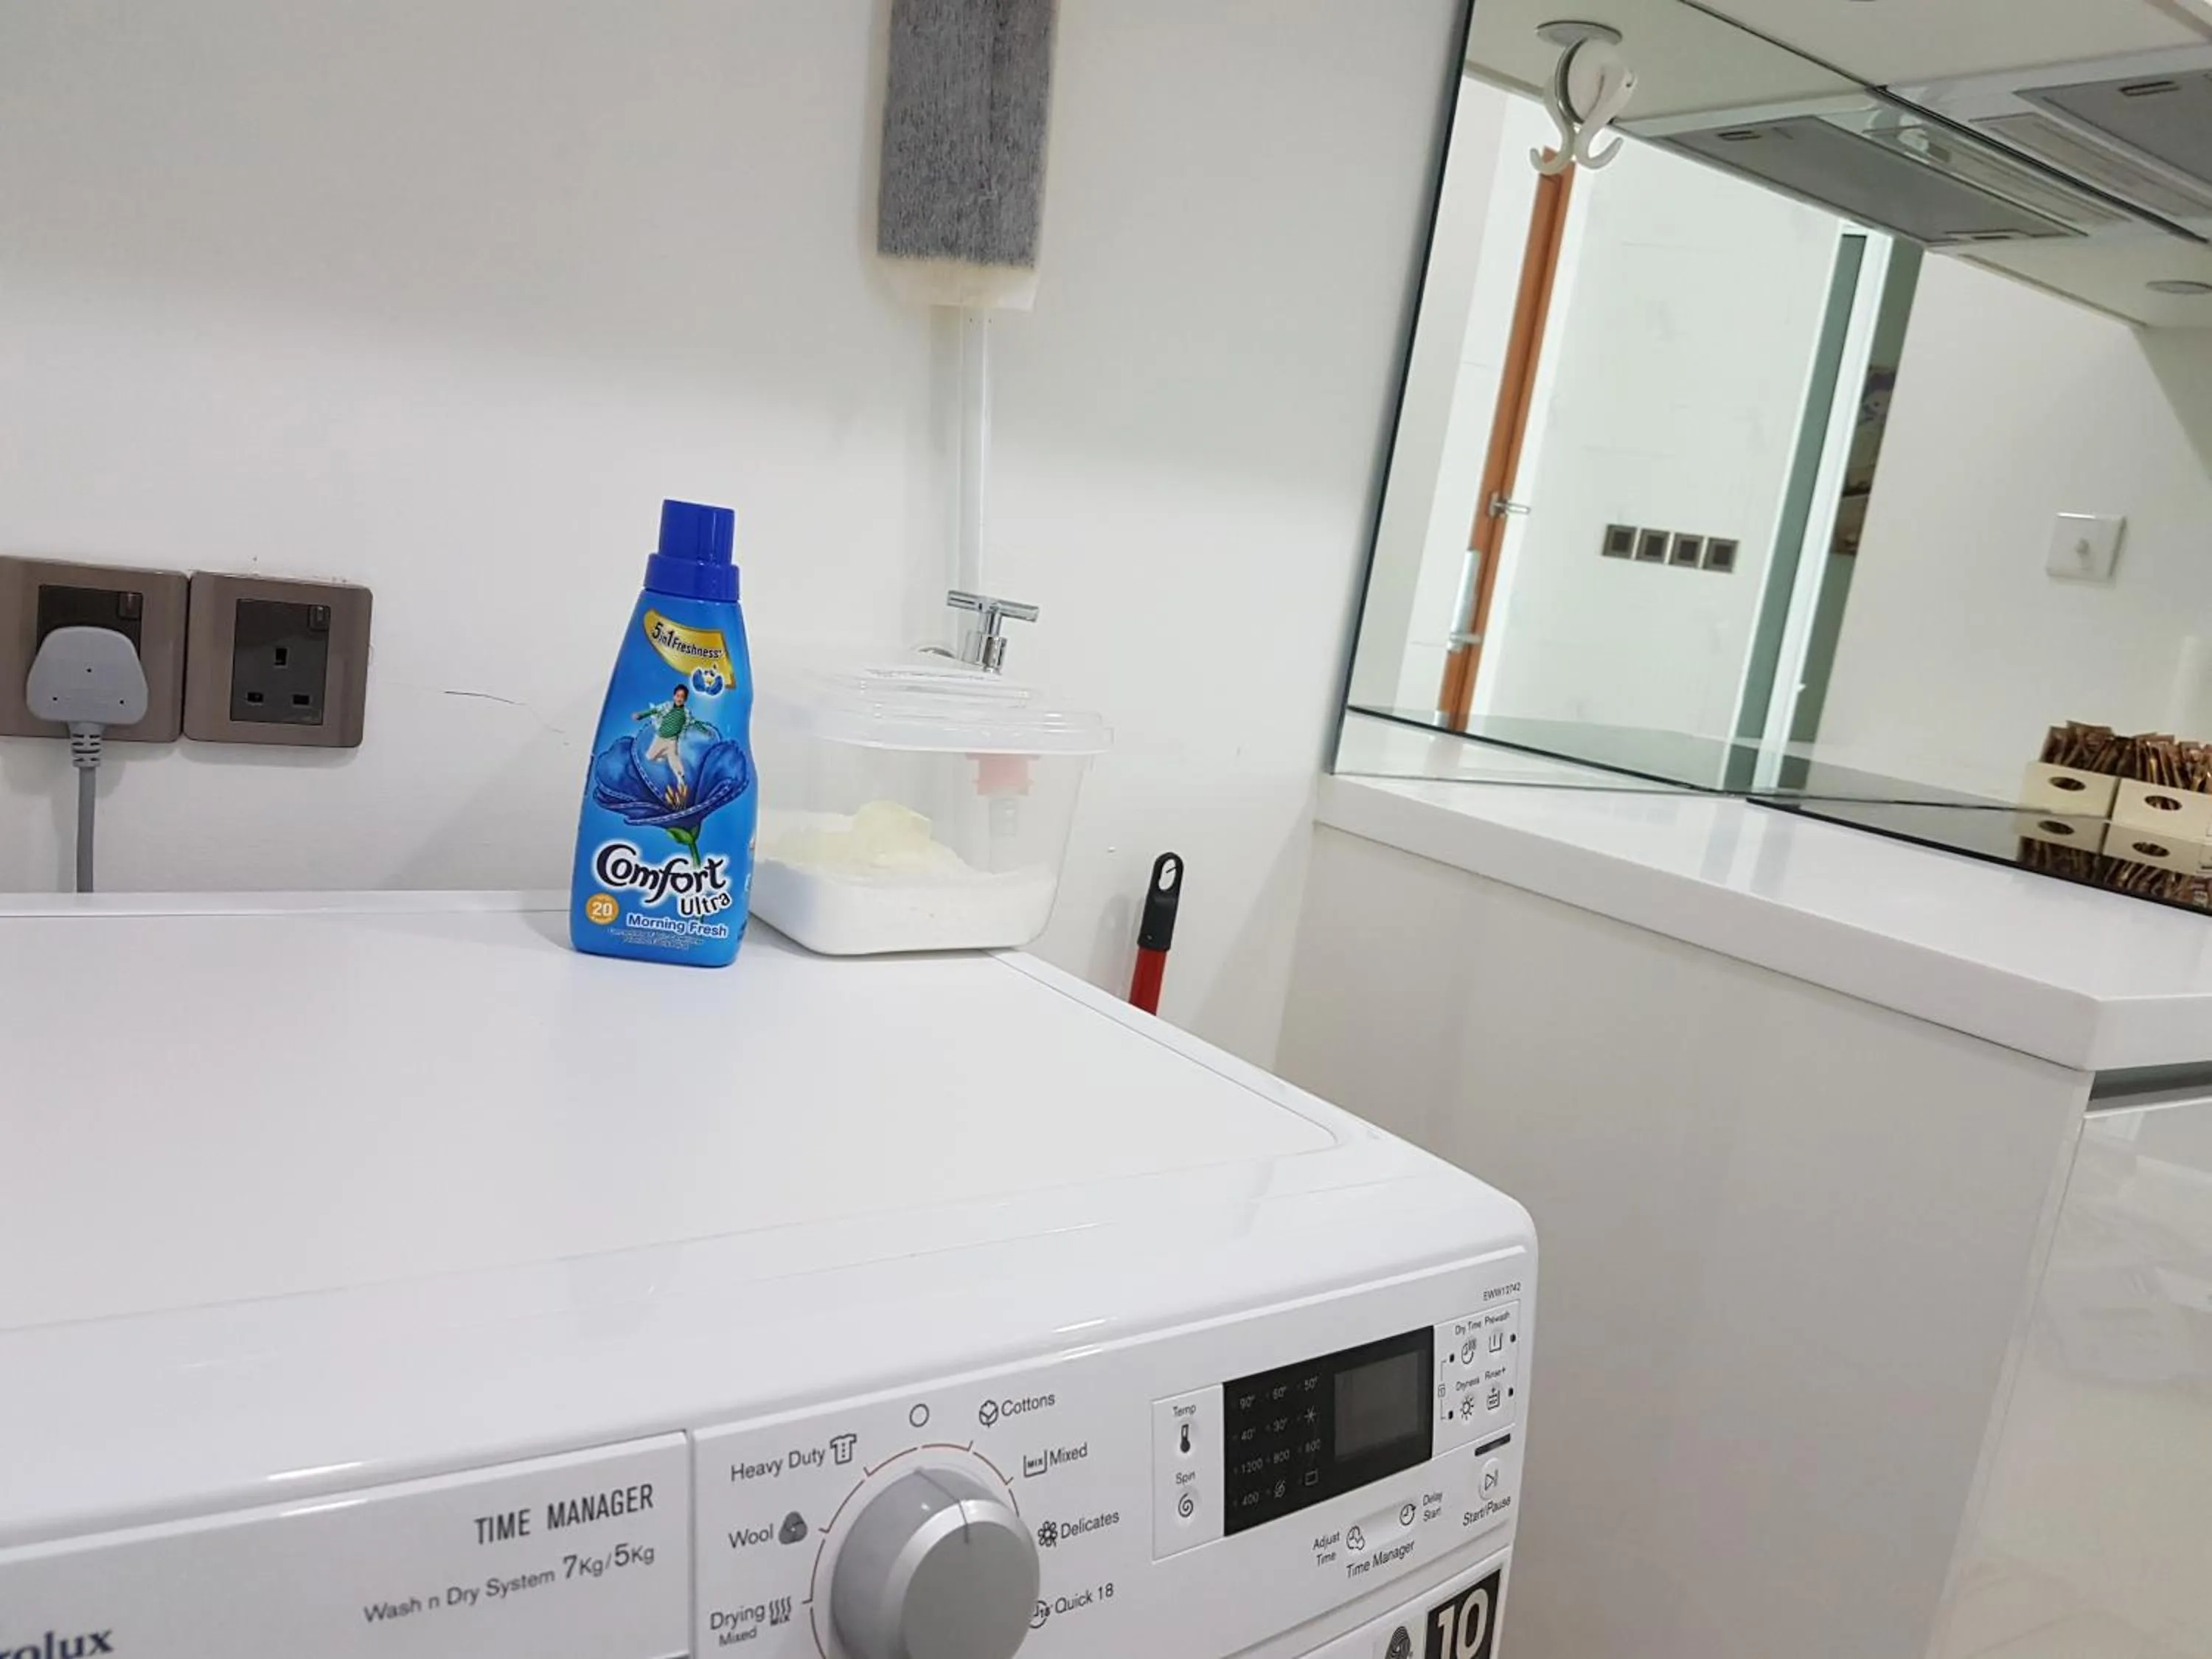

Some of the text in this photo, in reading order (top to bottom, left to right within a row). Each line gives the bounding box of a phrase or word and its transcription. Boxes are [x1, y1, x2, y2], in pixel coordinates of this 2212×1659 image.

[596, 843, 727, 904] Comfort
[591, 901, 613, 917] 20
[680, 891, 731, 916] Ultra
[627, 914, 728, 938] Morning Fresh
[1001, 1394, 1056, 1417] Cottons
[1172, 1404, 1197, 1416] Temp
[731, 1448, 826, 1483] Heavy Duty
[1049, 1441, 1088, 1467] Mixed
[1175, 1470, 1196, 1484] Spin
[1422, 1491, 1443, 1507] Delay
[1462, 1495, 1512, 1528] Start/Pause
[474, 1483, 655, 1545] TIME MANAGER
[1060, 1511, 1120, 1540] Delicates
[1422, 1507, 1441, 1523] Start
[728, 1522, 774, 1549] Wool
[1312, 1531, 1341, 1551] Adjust
[1315, 1551, 1337, 1567] Time
[1346, 1539, 1416, 1579] Time Manager
[363, 1596, 423, 1623] Wash
[428, 1595, 441, 1610] n
[446, 1585, 481, 1607] Dry
[484, 1568, 557, 1599] System
[1054, 1589, 1093, 1614] Quick
[1098, 1582, 1114, 1600] 18
[709, 1604, 765, 1631] Drying
[1437, 1587, 1490, 1659] 10
[719, 1624, 757, 1647] Mixed
